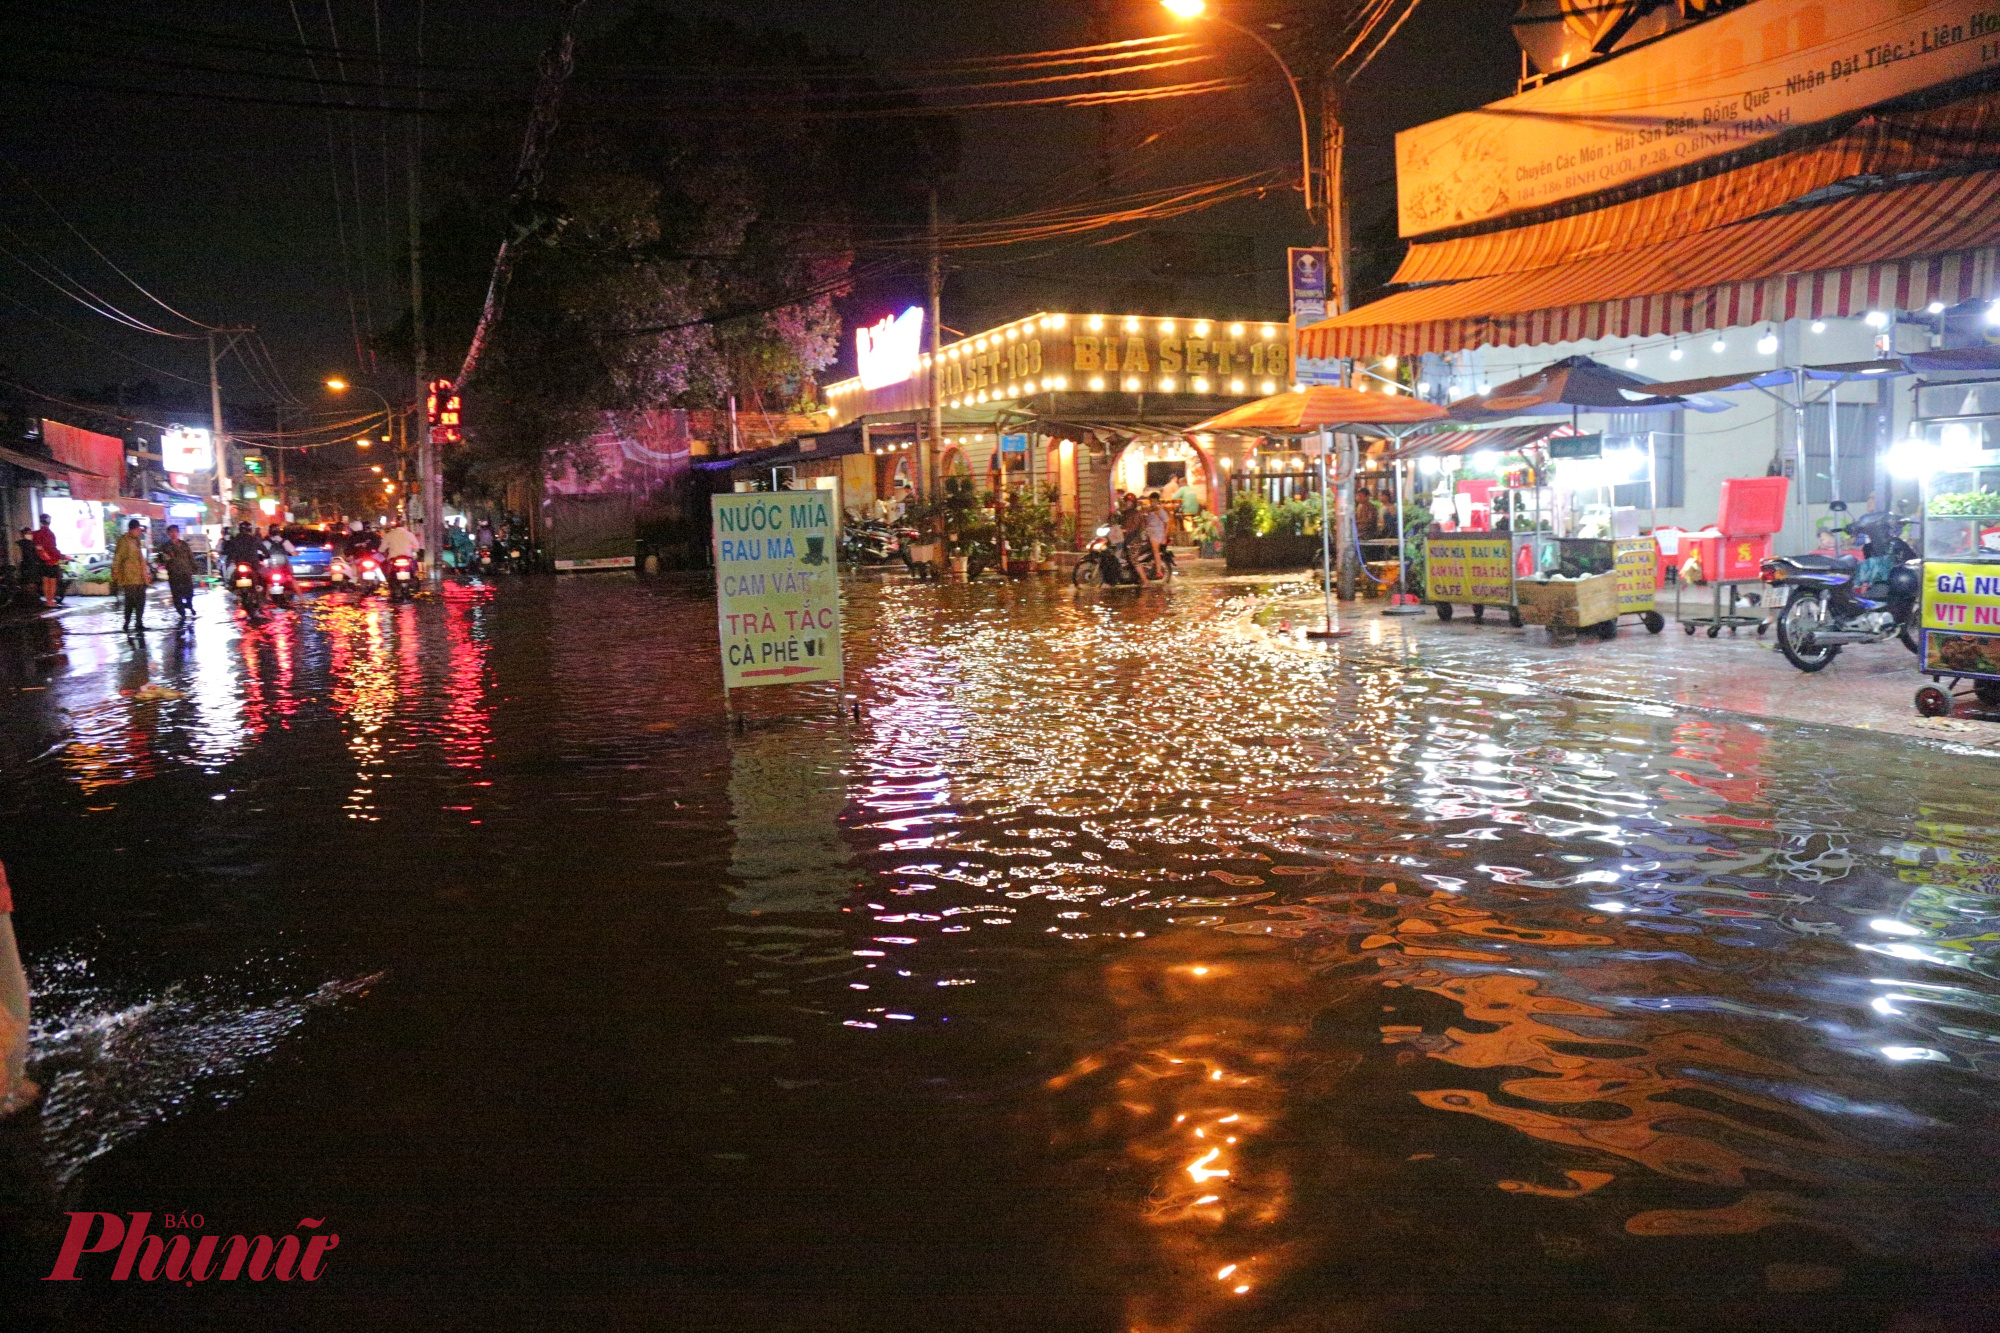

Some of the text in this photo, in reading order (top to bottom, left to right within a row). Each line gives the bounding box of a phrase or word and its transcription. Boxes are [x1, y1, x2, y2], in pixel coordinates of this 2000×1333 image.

[1516, 160, 1552, 182] Chuyên
[1556, 153, 1576, 171] Các
[1580, 145, 1604, 164] Món
[1743, 86, 1770, 113] Quê
[1786, 70, 1825, 97] Nhận
[1831, 54, 1861, 82] Đặt
[1865, 42, 1902, 69] Tiệc
[1922, 24, 1963, 53] Liên
[1733, 106, 1791, 139] THẠNH
[1074, 336, 1150, 372] BIA
[720, 497, 828, 532] NƯỚC MÍA
[722, 531, 795, 562] RAU MÁ
[725, 561, 809, 597] CAM VẮT
[1938, 572, 1967, 594] GÀ
[726, 599, 833, 635] TRÀ TẮC
[1934, 603, 1967, 626] VỊT
[729, 635, 799, 666] CÀ PHÊ
